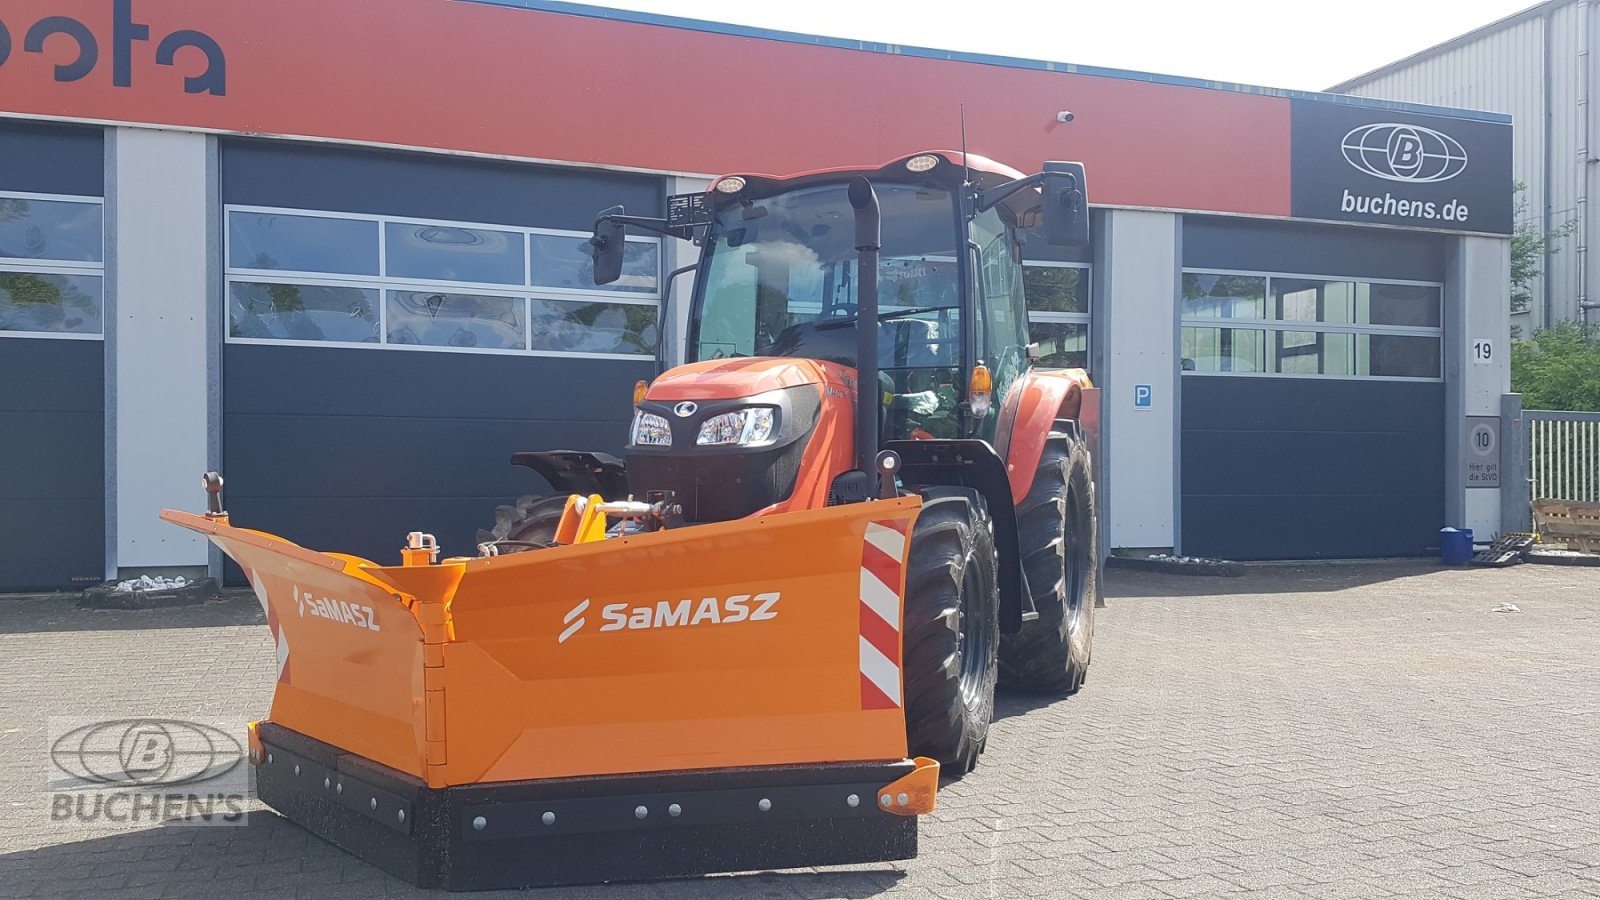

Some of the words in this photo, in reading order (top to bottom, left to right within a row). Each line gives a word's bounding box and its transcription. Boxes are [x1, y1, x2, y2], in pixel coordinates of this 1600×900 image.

[0, 0, 226, 97] ota
[1341, 189, 1469, 222] buchens.de
[1474, 342, 1492, 359] 19
[1137, 387, 1149, 404] P
[1476, 432, 1490, 447] 10
[1469, 463, 1484, 471] Hier
[1486, 463, 1497, 473] gilt
[1469, 472, 1479, 481] die
[303, 592, 381, 632] SaMASZ
[600, 592, 780, 632] SaMASZ
